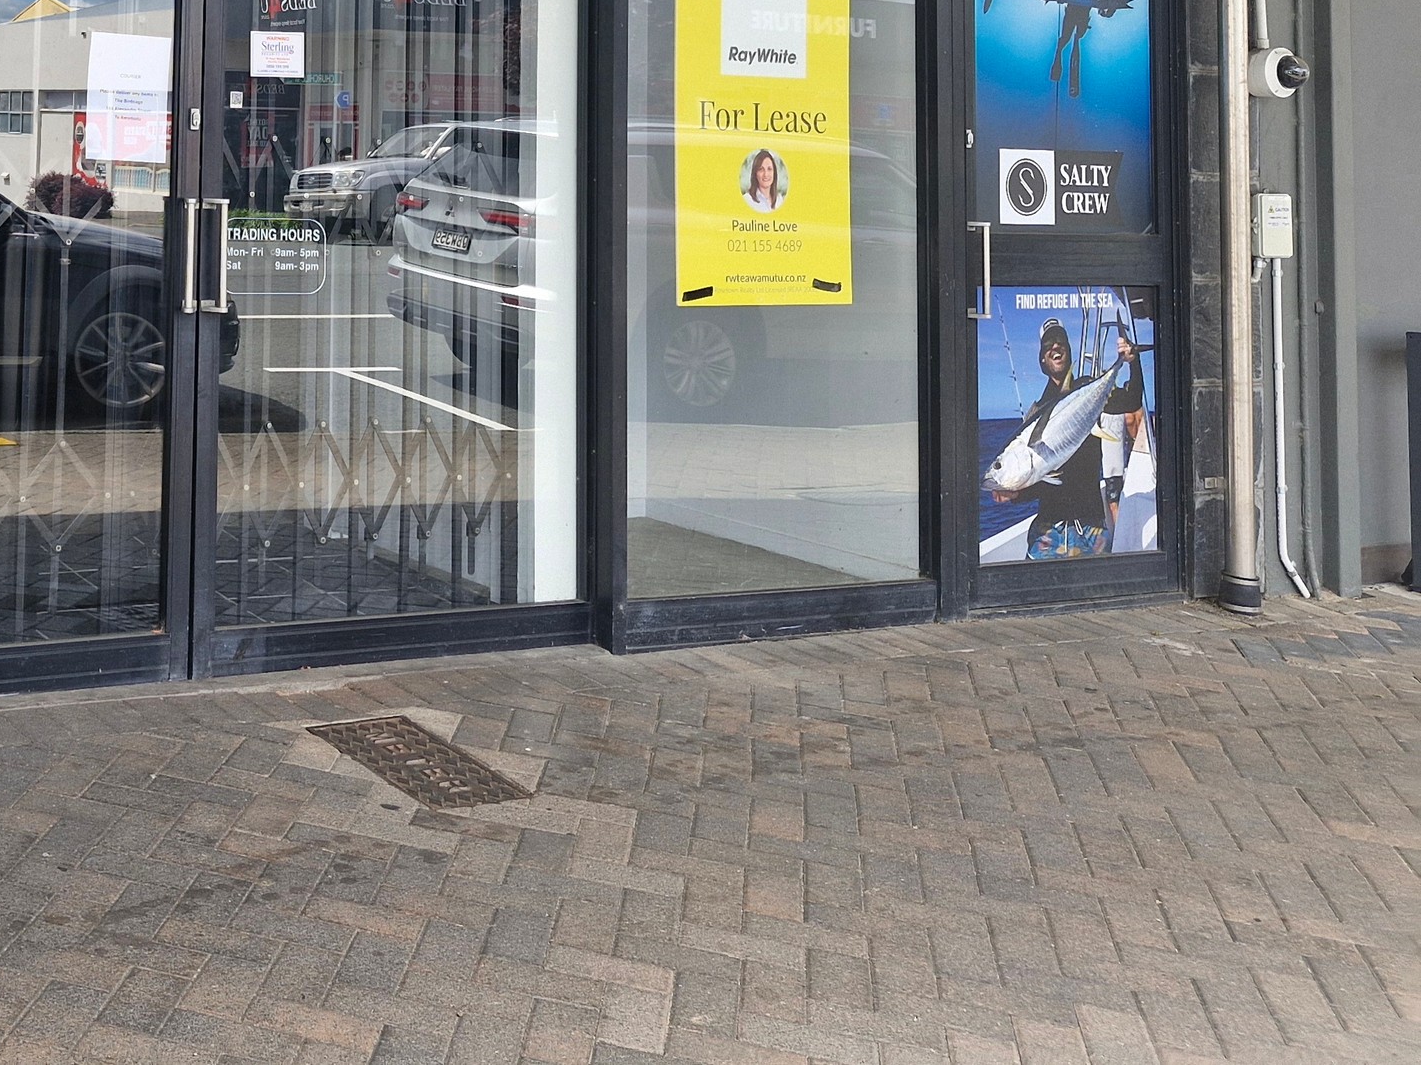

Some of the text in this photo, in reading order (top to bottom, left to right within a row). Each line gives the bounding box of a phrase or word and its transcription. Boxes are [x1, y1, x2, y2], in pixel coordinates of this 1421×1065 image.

[261, 41, 294, 54] Sterling
[699, 101, 827, 134] For Lease
[1060, 164, 1112, 186] SALTY
[1062, 192, 1109, 214] CREW
[732, 219, 798, 232] Pauline Love
[227, 228, 321, 242] TRADING HOURS
[727, 239, 802, 252] 021 155 4689
[251, 247, 264, 256] Fri
[300, 248, 319, 259] 5pm
[226, 261, 241, 270] Sat
[299, 262, 319, 272] 3pm
[725, 274, 806, 283] rwteawamutu.co.nz
[1016, 293, 1113, 309] FIND REFUGE IN THE SEA
